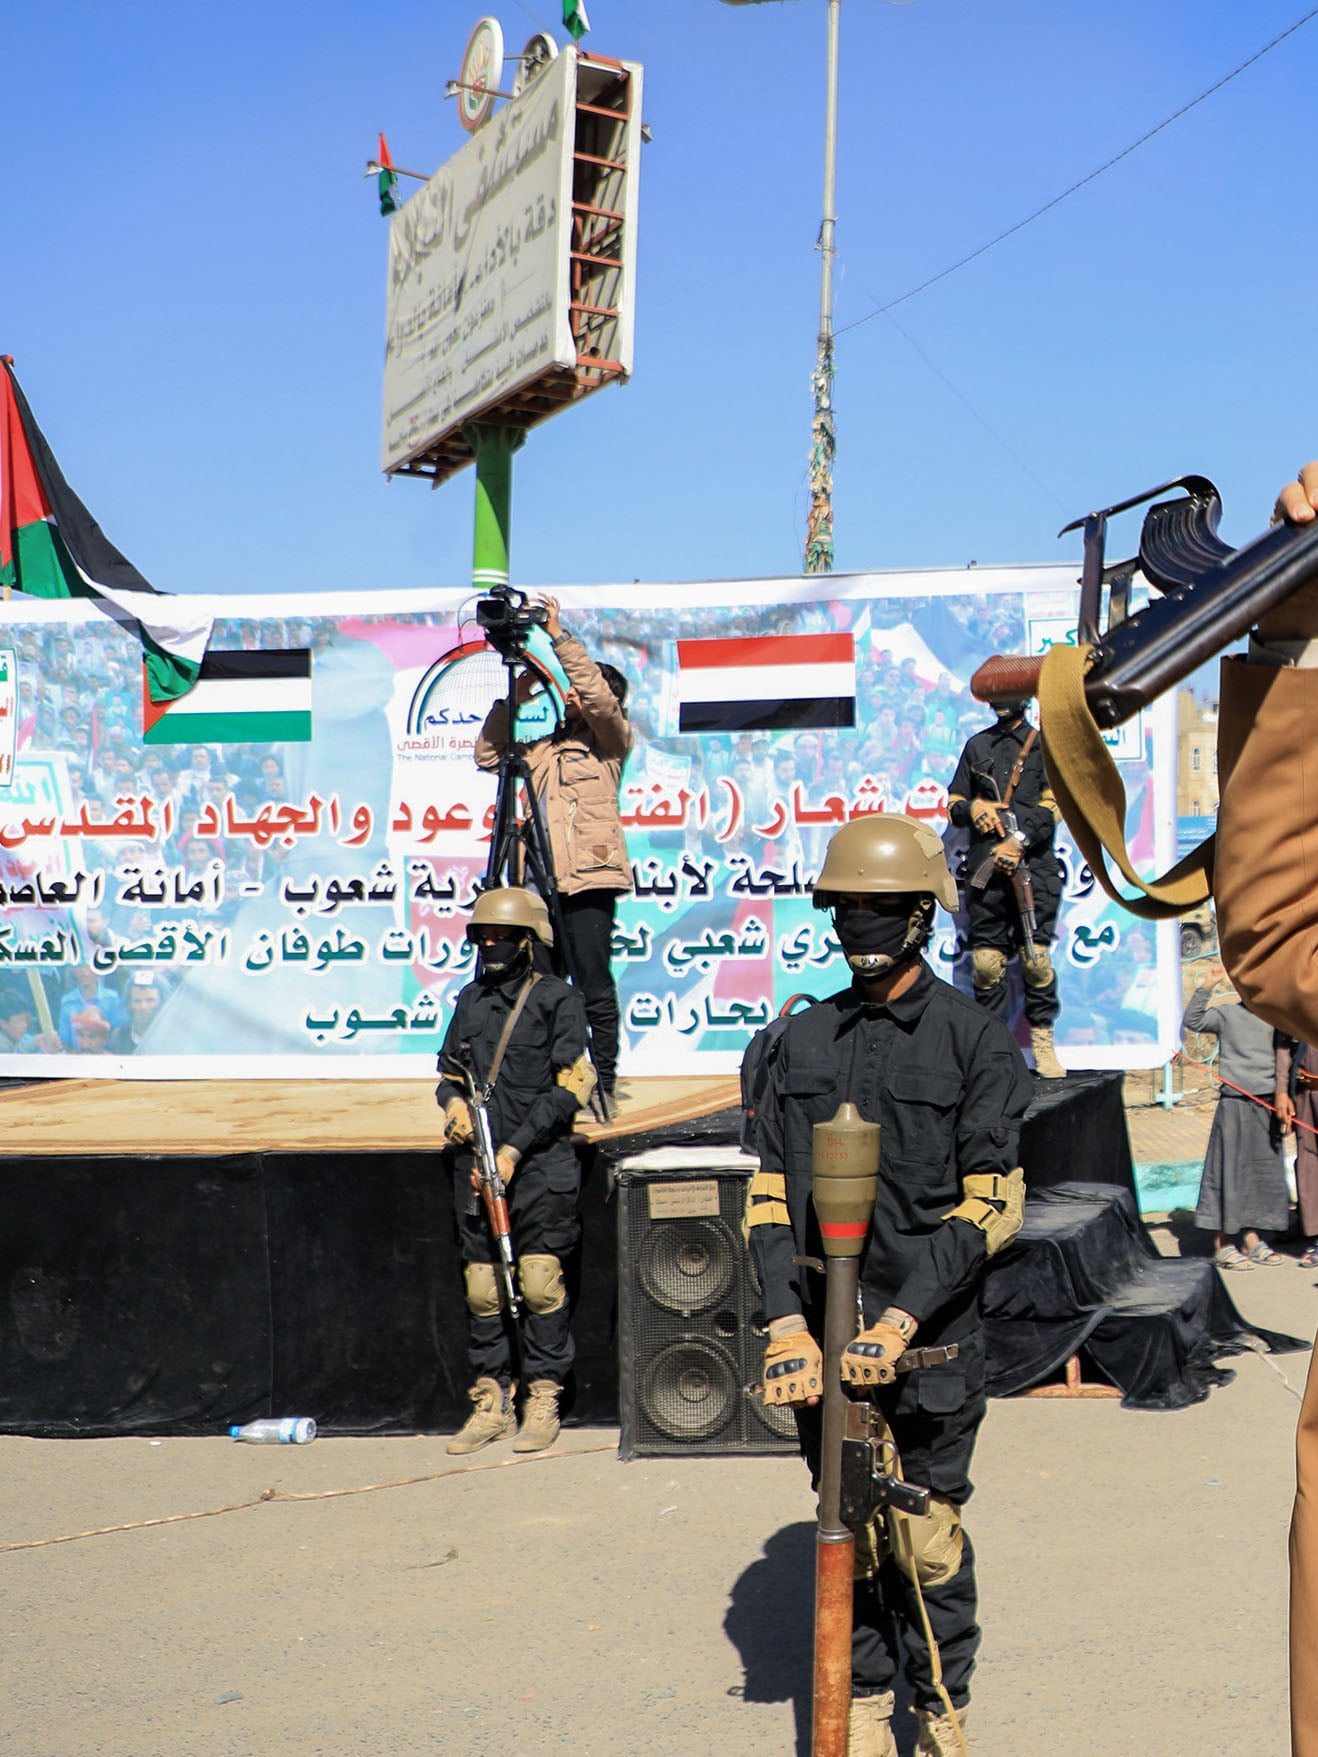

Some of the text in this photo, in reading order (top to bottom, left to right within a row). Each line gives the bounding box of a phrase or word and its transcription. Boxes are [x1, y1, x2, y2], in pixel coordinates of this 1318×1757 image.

[0, 795, 172, 848] المقدس
[197, 795, 373, 847] والجهاد
[121, 861, 222, 904] أمانة
[284, 863, 398, 915] شعوب
[93, 924, 229, 971] الأقصى
[246, 927, 365, 971] طوفان
[667, 919, 766, 973] شعبي
[1072, 925, 1116, 962] مع
[306, 995, 439, 1041] شعوب
